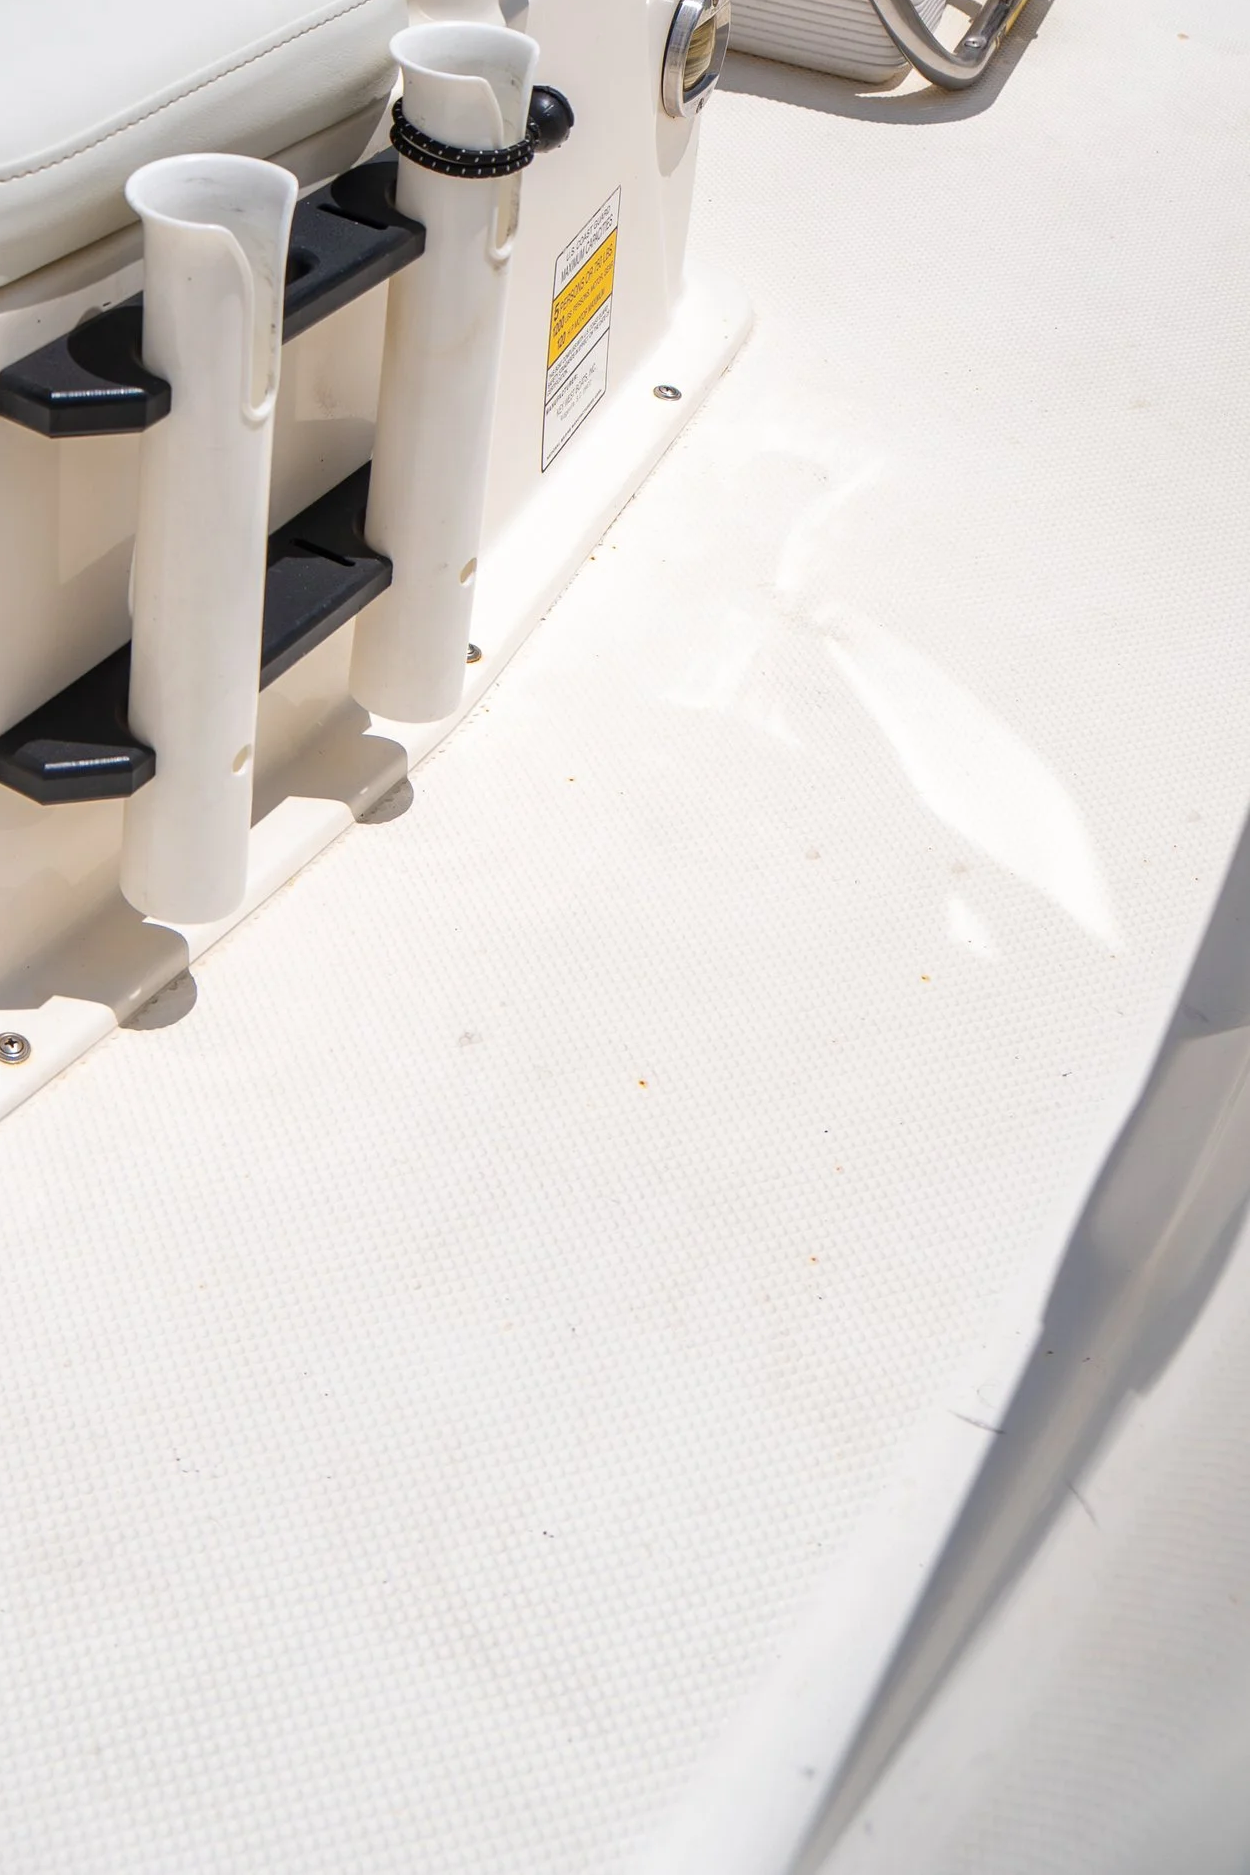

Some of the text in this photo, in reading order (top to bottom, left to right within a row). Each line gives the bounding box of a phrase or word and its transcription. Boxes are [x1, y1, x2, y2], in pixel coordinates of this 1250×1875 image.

[560, 212, 613, 284] MAXIMUM CAPACITIES
[576, 224, 593, 251] COAST
[593, 203, 611, 231] GUARD
[553, 301, 560, 324] 5
[559, 275, 584, 315] PERSONS
[584, 265, 593, 285] OR
